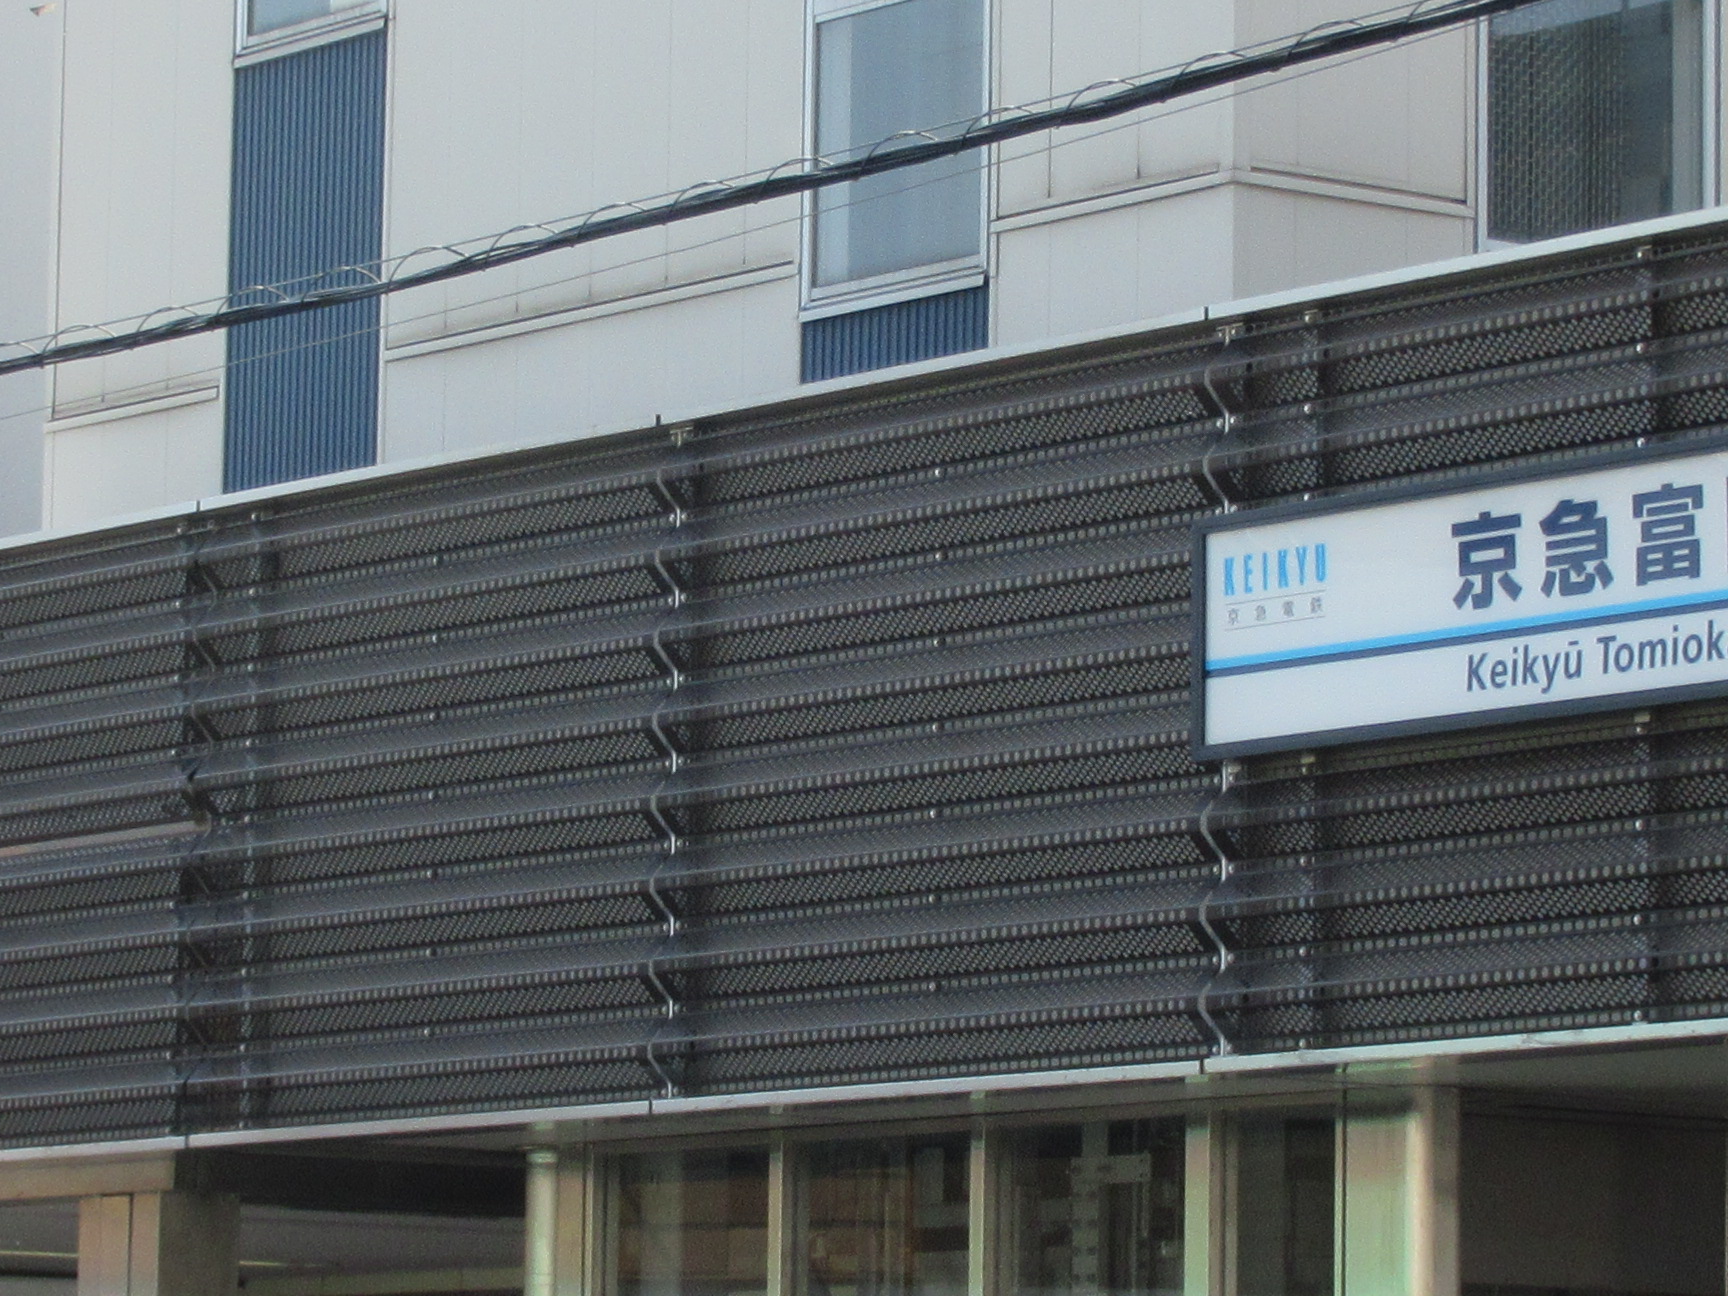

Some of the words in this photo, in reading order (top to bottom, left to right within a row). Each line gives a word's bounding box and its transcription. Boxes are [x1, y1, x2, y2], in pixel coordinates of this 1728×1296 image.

[1223, 543, 1326, 596] KEIKYU
[1226, 596, 1323, 625] 京急電鉄
[1465, 640, 1584, 694] Keikyū
